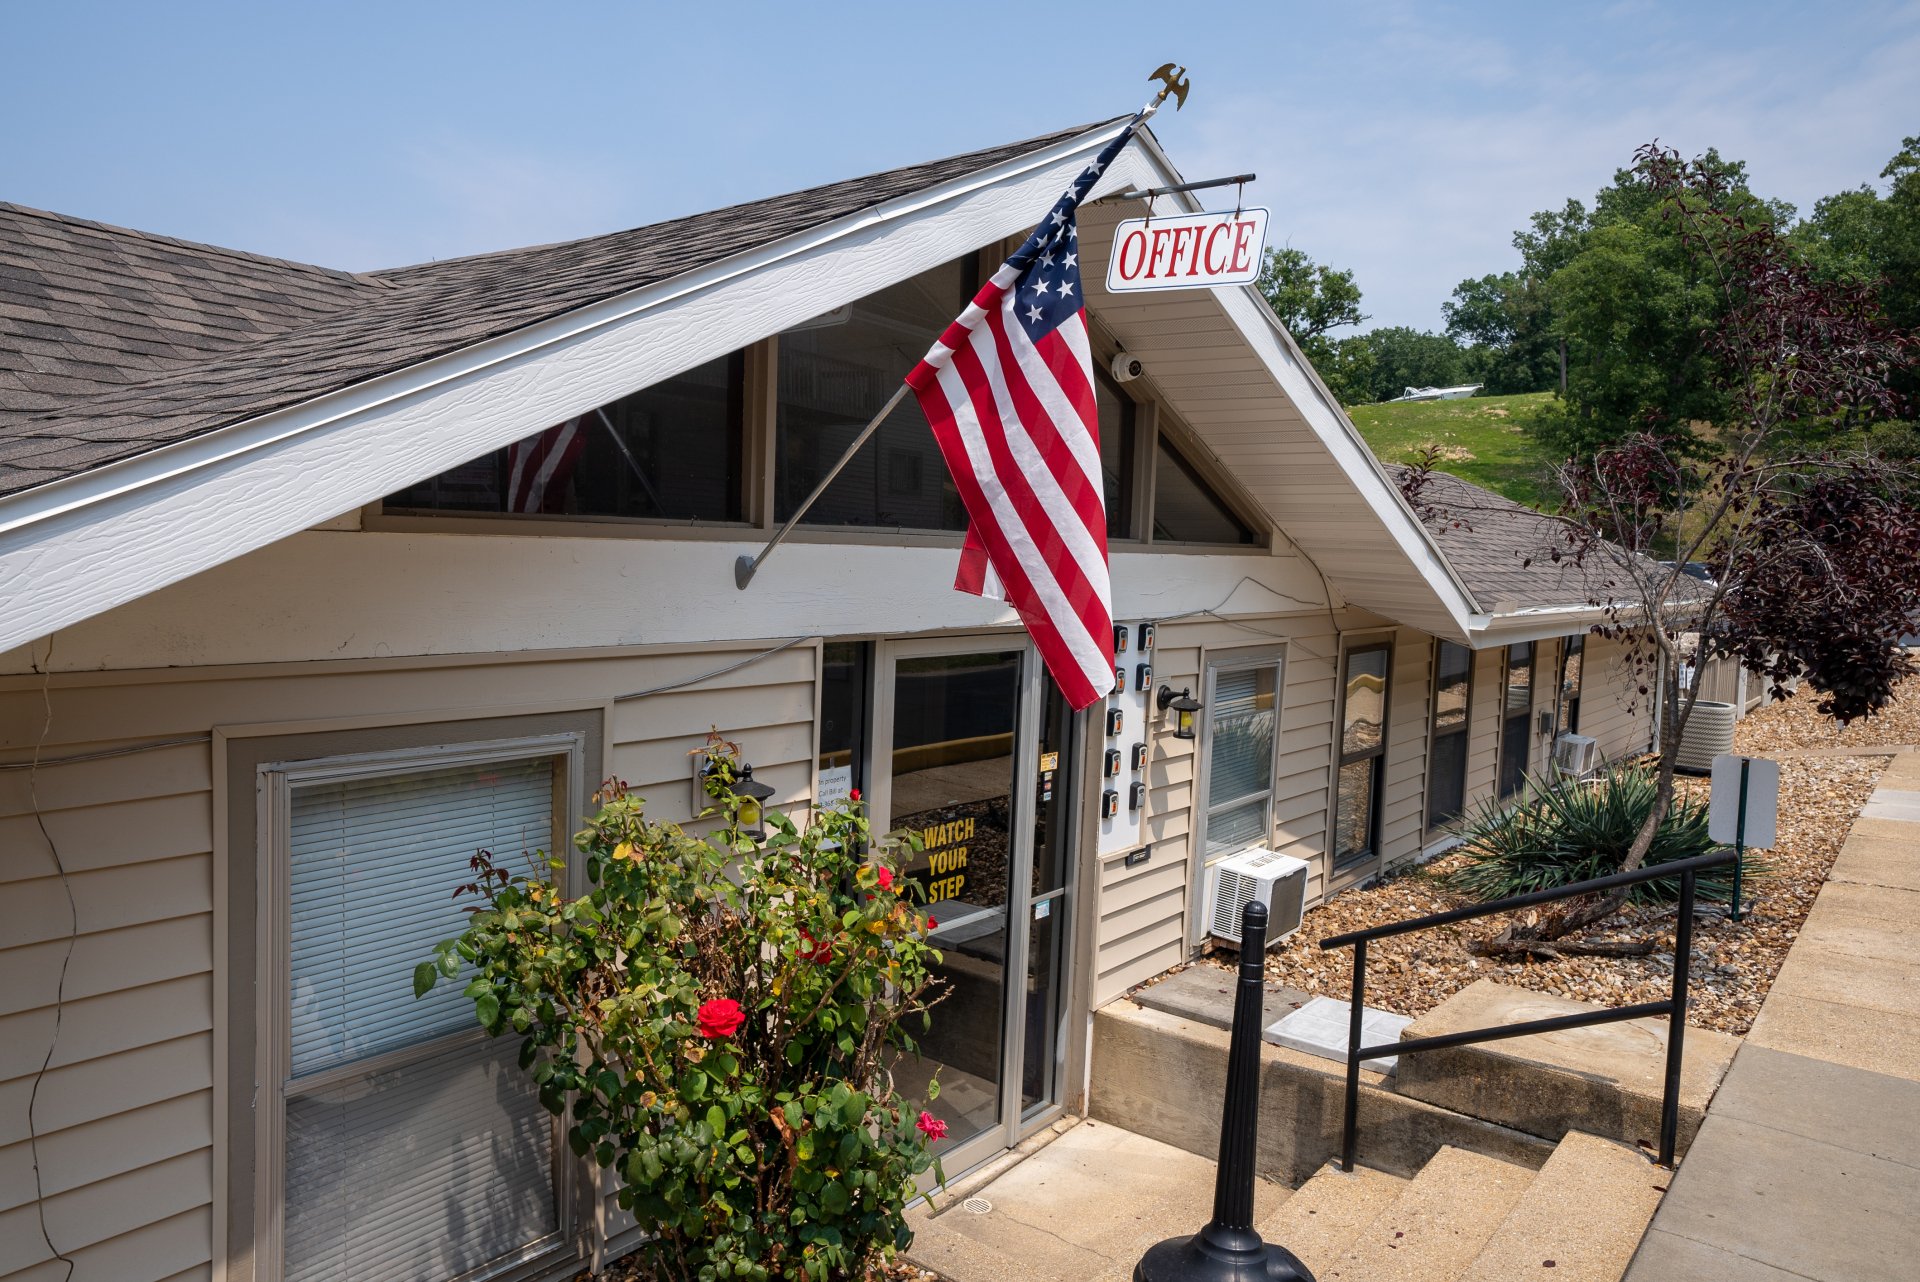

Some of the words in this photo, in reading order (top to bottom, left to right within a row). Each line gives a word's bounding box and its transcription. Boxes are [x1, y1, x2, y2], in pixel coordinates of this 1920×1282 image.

[1119, 220, 1256, 281] OFFICE
[819, 789, 829, 797] Call
[829, 788, 837, 796] Bill
[825, 775, 847, 786] property
[924, 817, 975, 850] WATCH
[928, 846, 968, 877] YOUR
[928, 874, 965, 904] STEP
